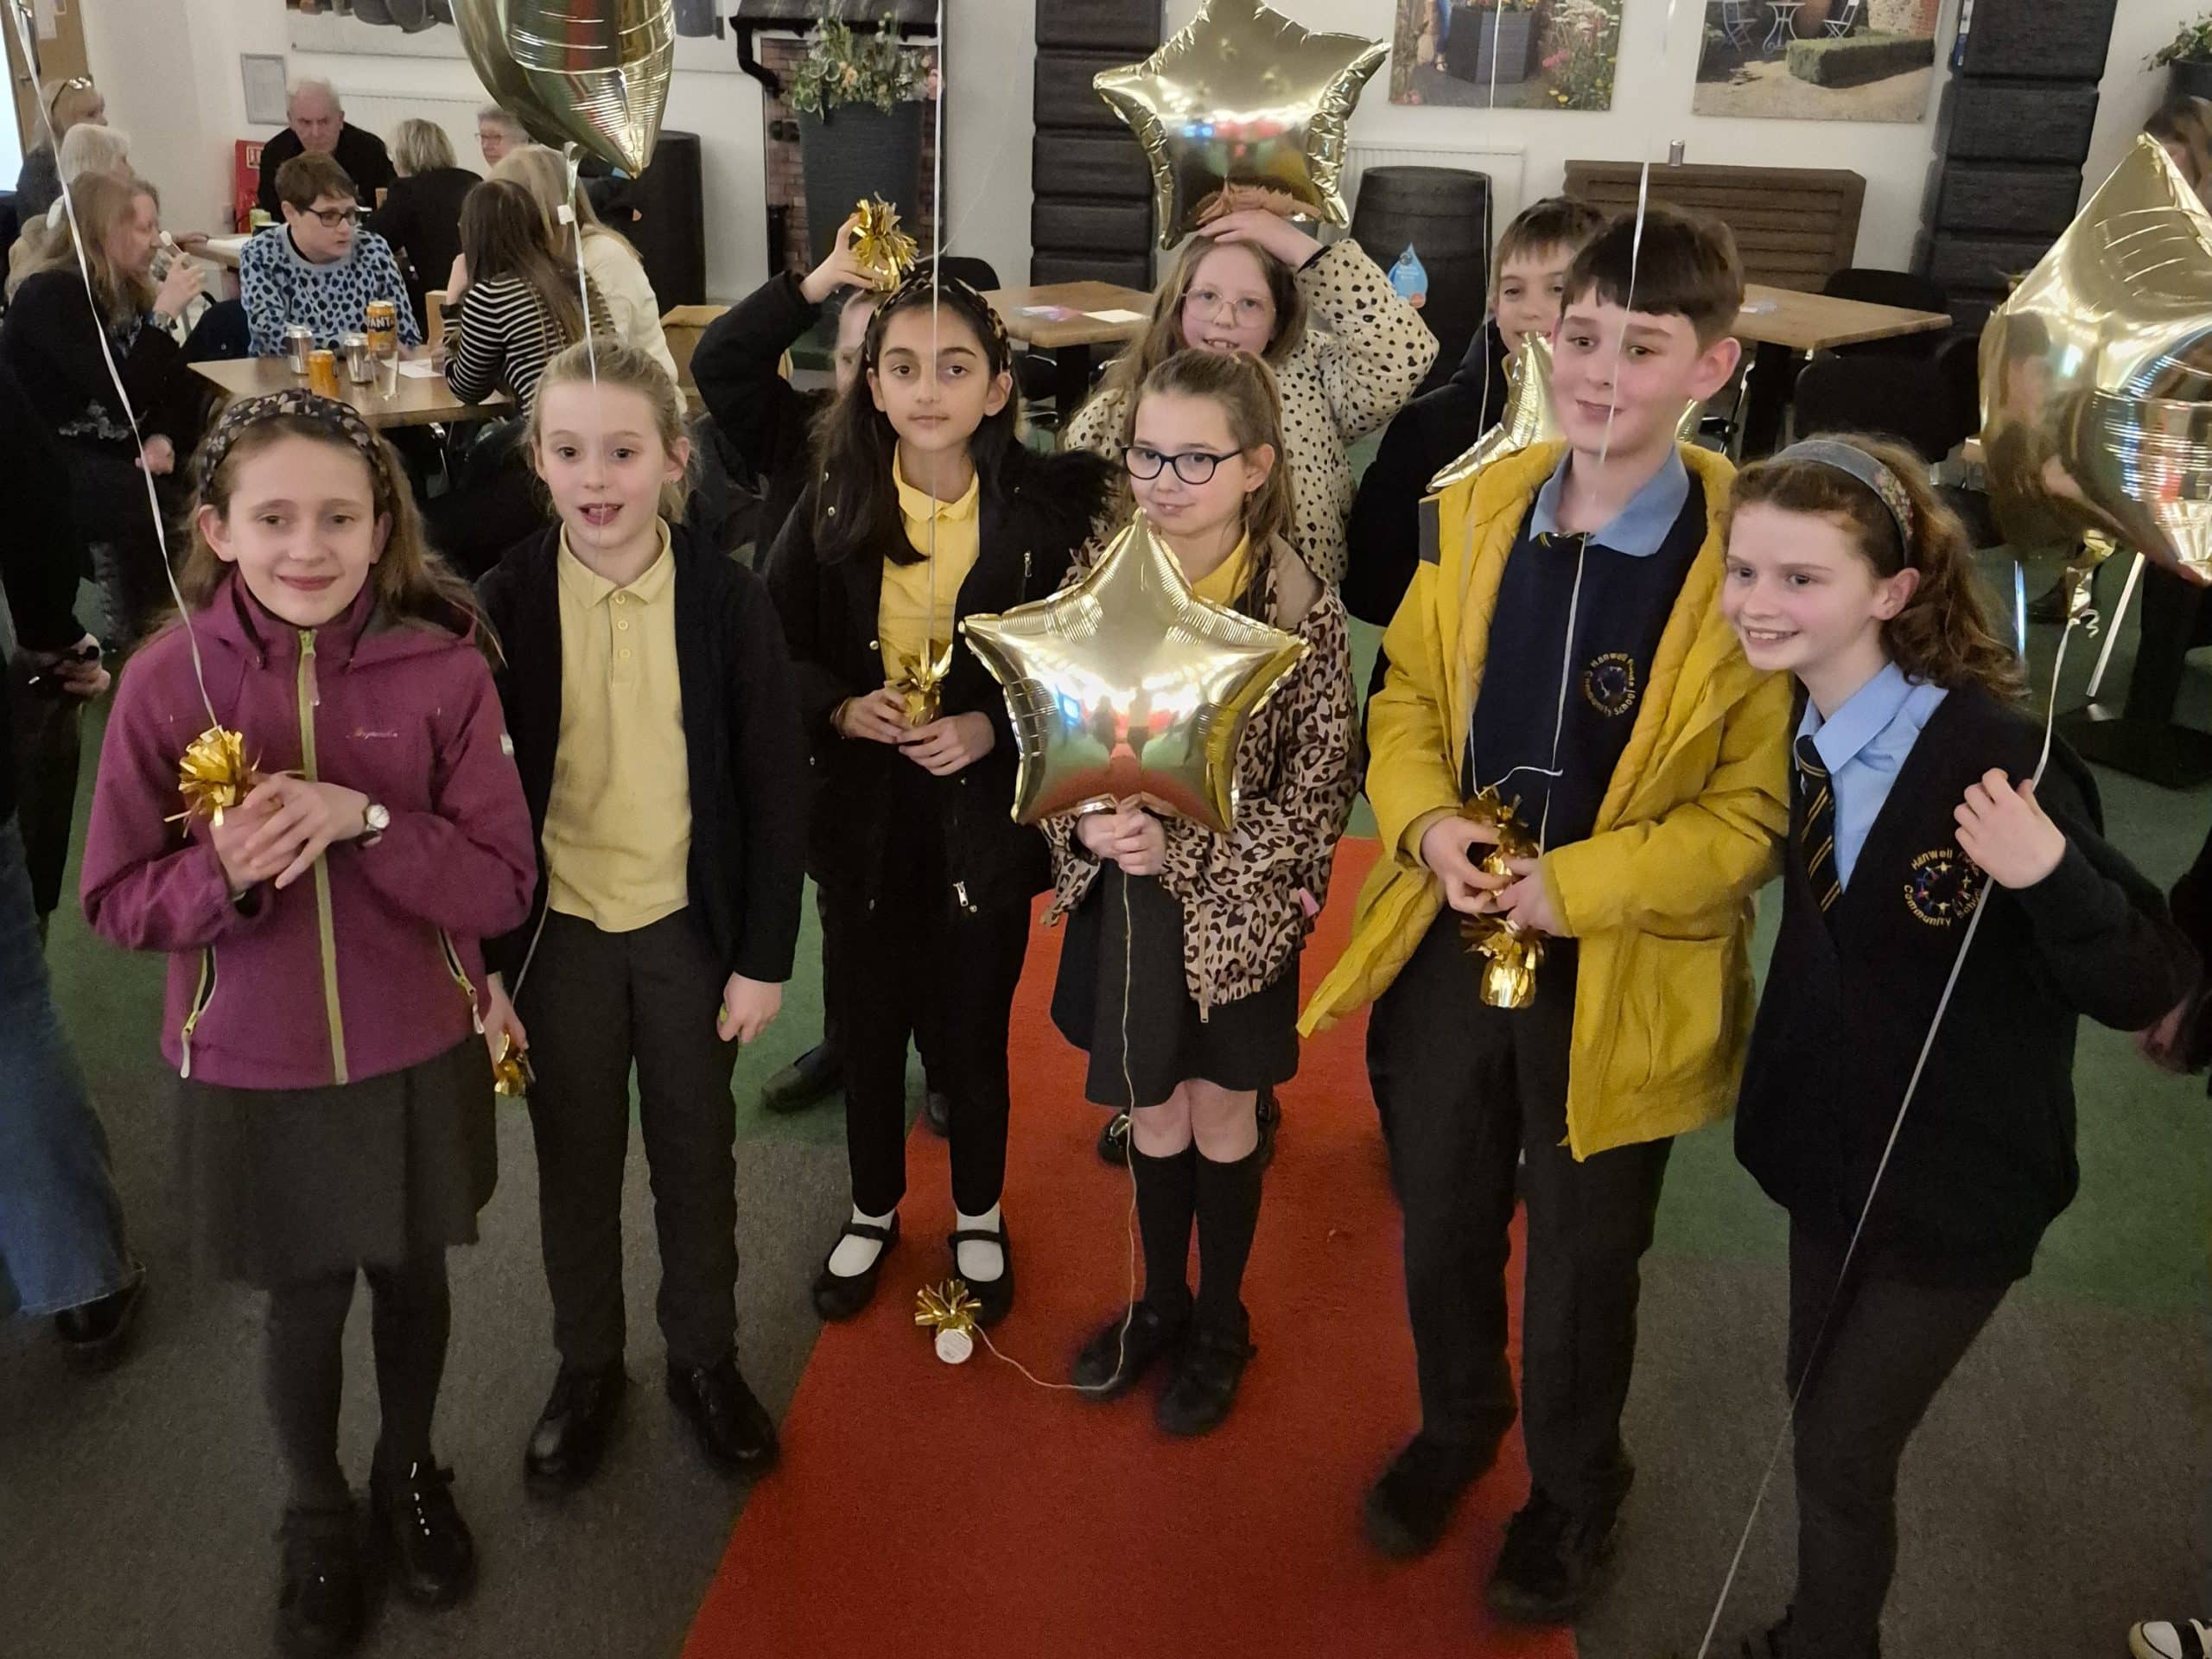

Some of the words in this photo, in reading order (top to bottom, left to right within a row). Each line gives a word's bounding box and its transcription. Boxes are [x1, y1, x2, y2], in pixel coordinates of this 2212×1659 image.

[1590, 652, 1629, 668] Hanwell
[1910, 849, 1953, 871] Hanwell
[1904, 884, 1951, 926] Community
